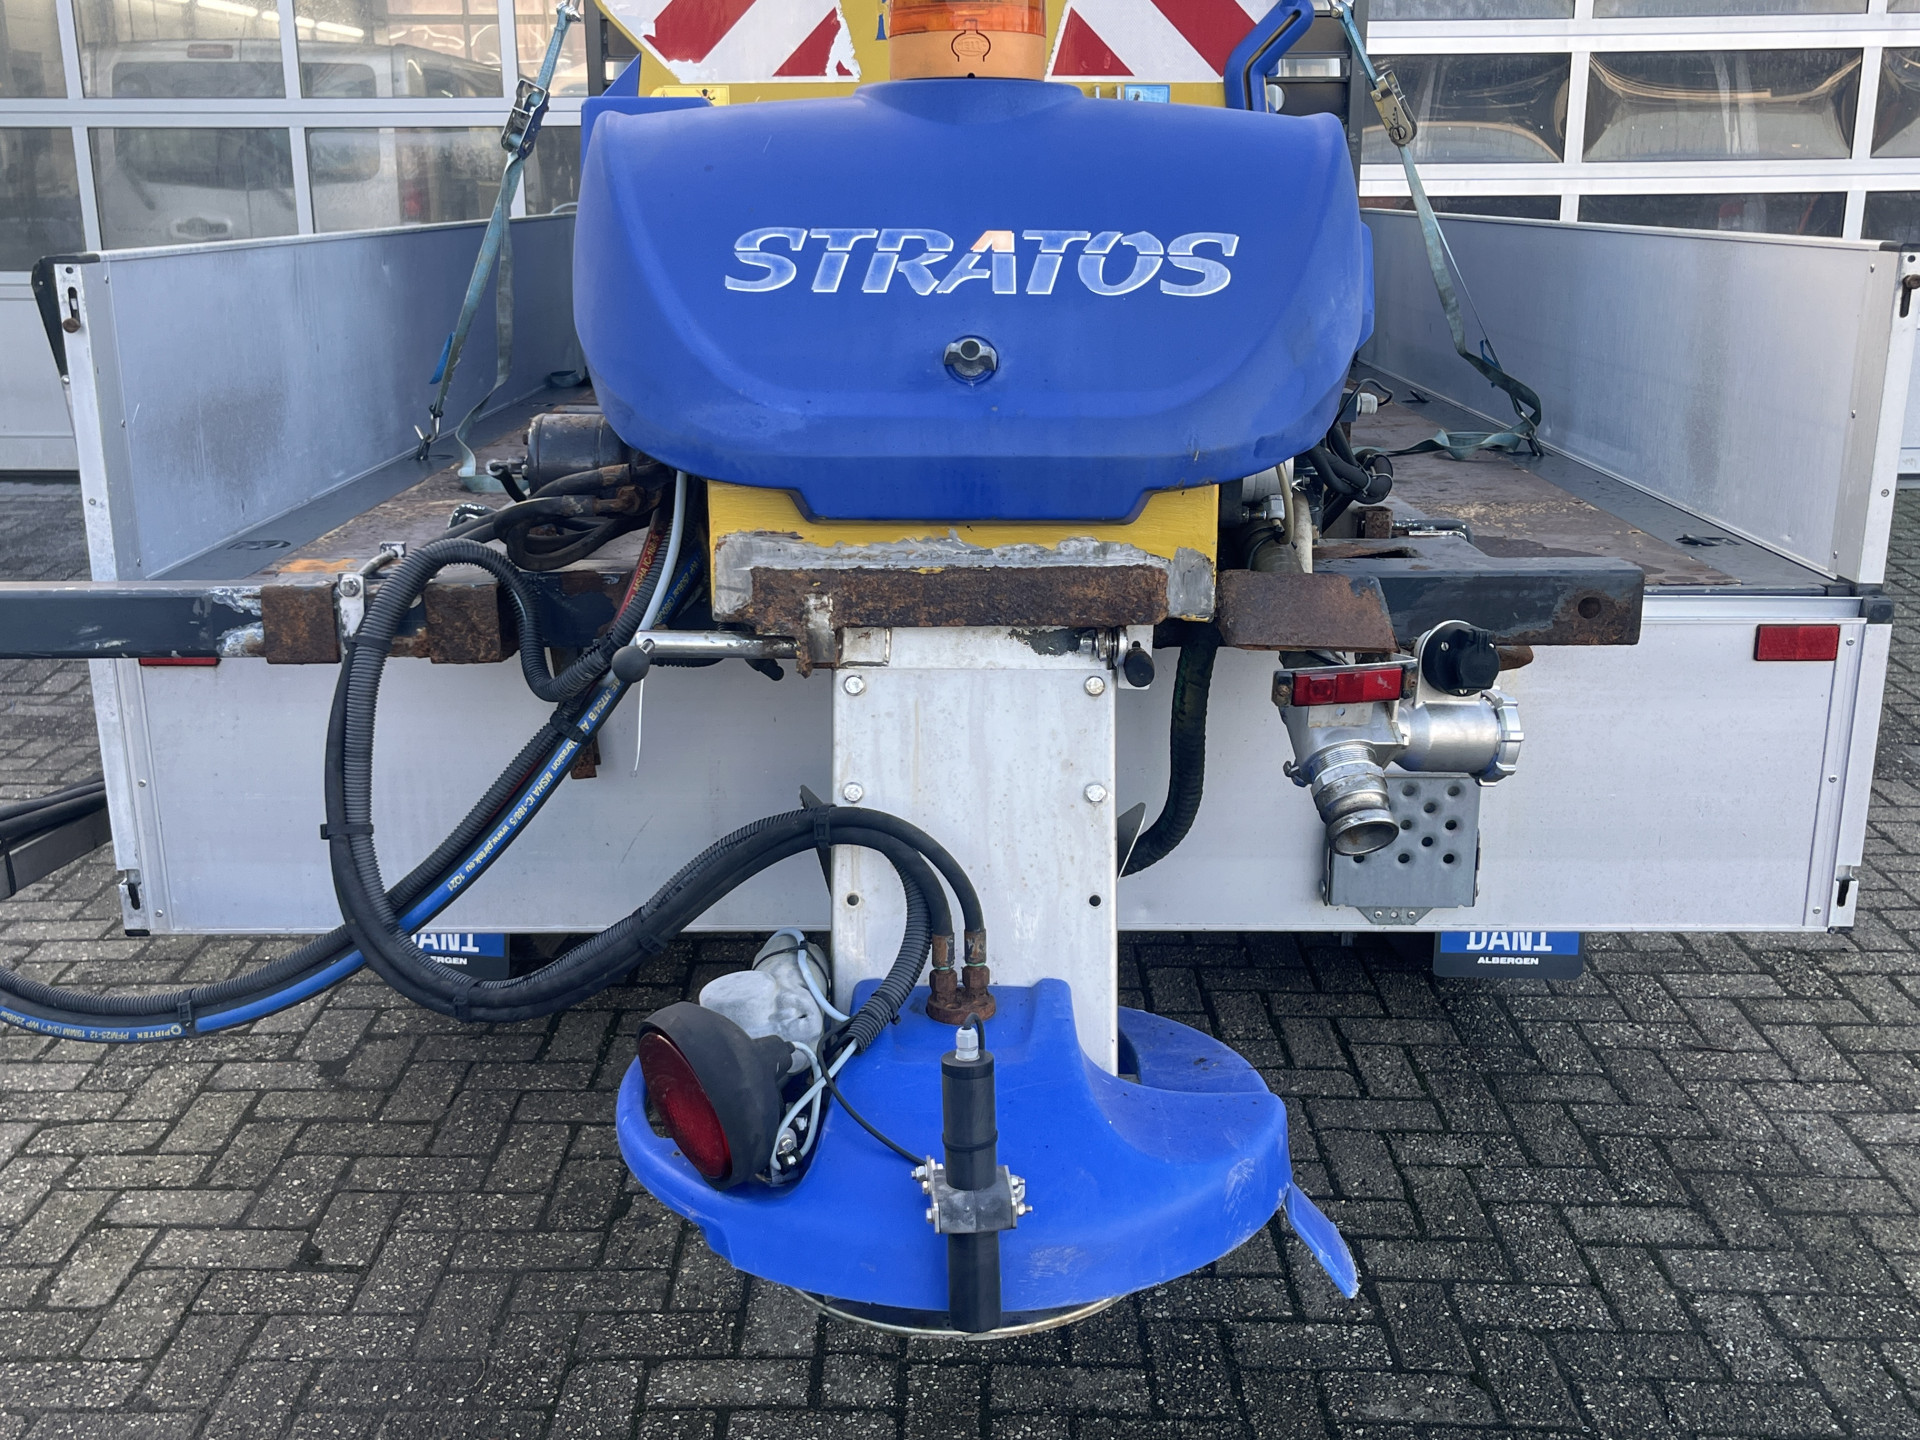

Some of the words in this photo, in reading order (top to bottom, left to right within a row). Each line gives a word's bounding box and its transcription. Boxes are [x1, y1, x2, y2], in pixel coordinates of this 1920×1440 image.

[725, 227, 1239, 297] STRATOS
[532, 771, 554, 797] MSHA
[465, 824, 511, 873] www.pirtek.eu
[1477, 956, 1539, 965] ALBERGEN
[90, 1031, 130, 1040] PFM25-12
[137, 1029, 171, 1039] PIRTEK
